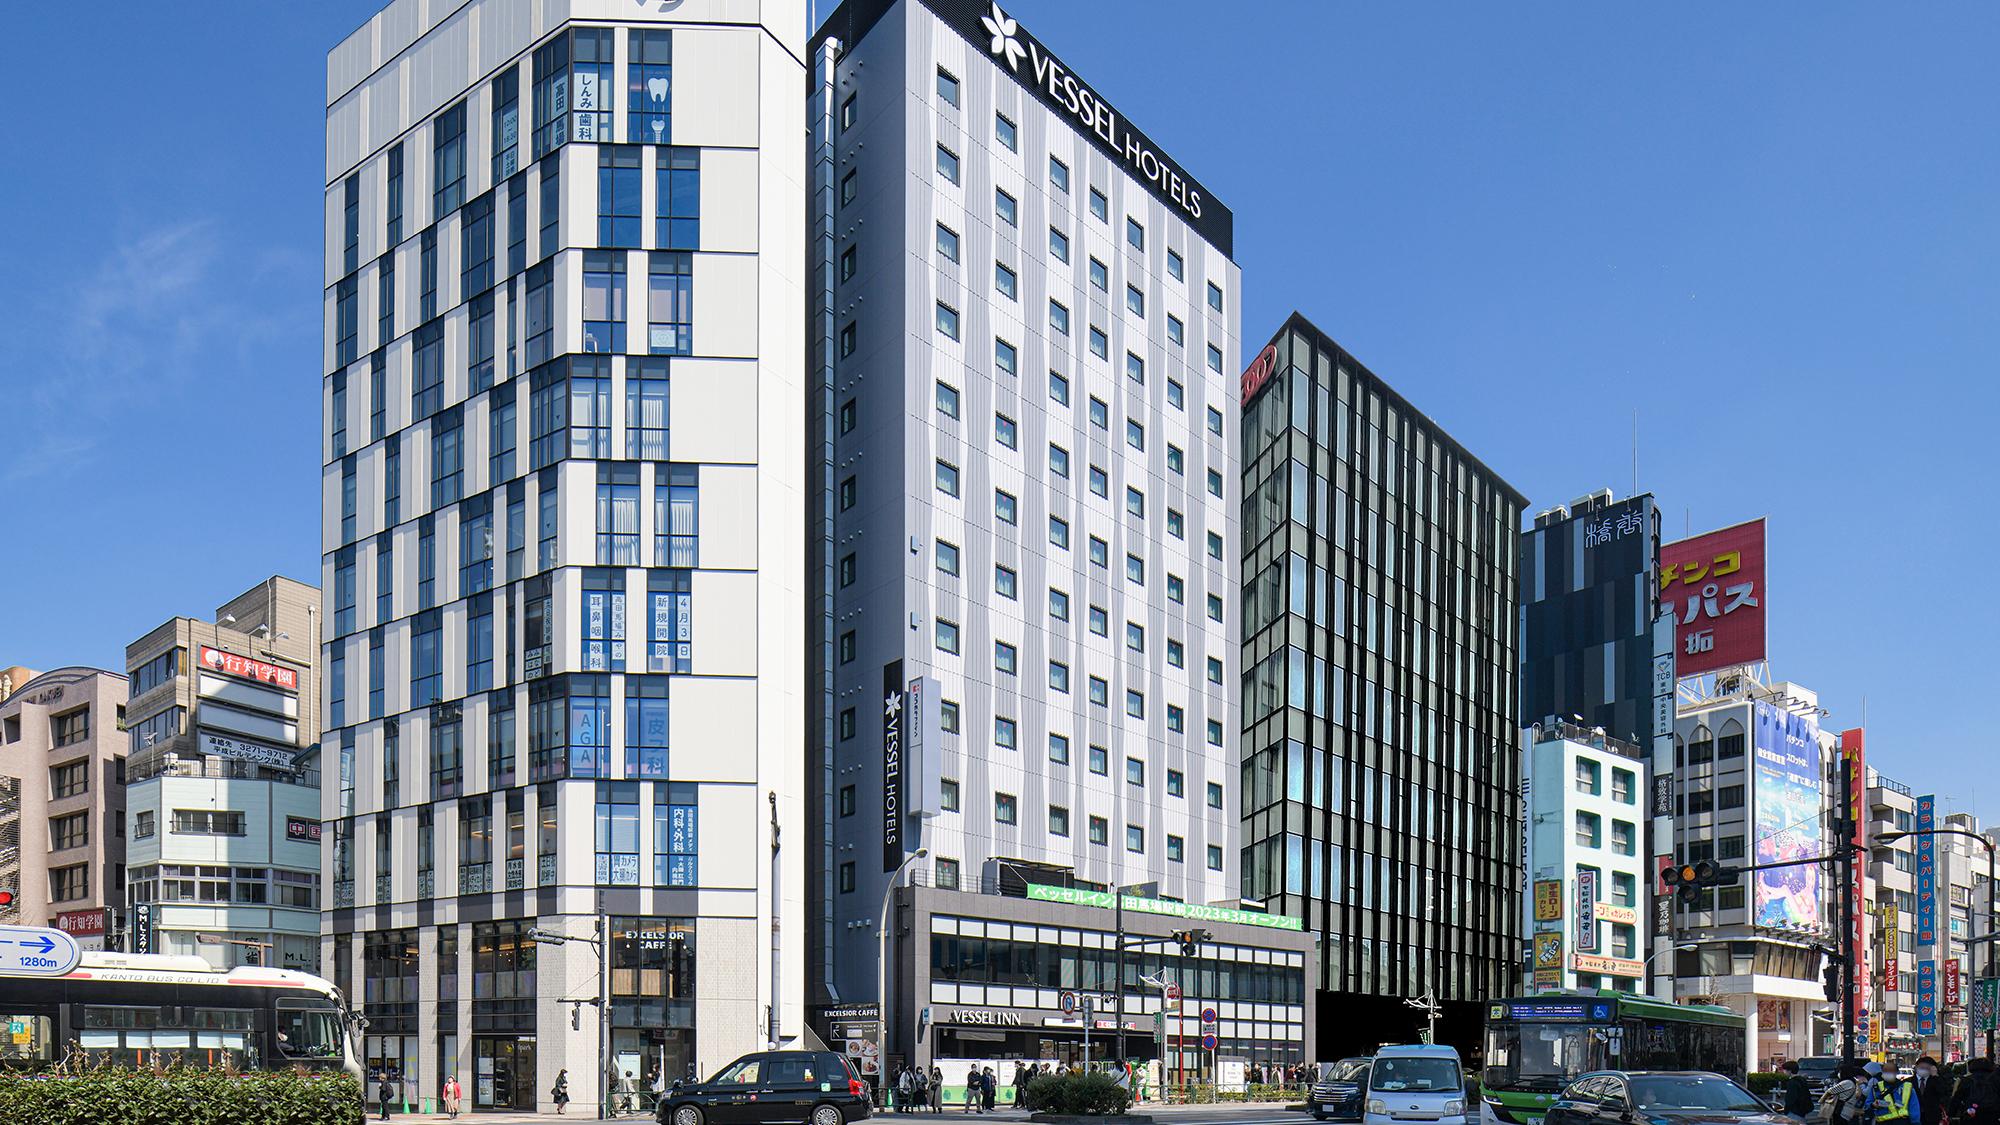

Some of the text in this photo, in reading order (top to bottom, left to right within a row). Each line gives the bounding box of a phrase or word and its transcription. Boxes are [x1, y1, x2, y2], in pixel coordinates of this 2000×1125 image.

[1028, 41, 1202, 219] VESSEL HOTELS
[656, 597, 667, 656] 新規開院
[1656, 672, 1671, 681] TCB
[579, 714, 591, 763] AGA
[886, 717, 898, 845] VESSEL HOTELS
[68, 913, 103, 931] 行知学園
[625, 930, 685, 940] EXCELSOR
[19, 956, 57, 967] 1280m
[100, 973, 143, 981] KANTO
[953, 1010, 1021, 1025] VESSEL INN
